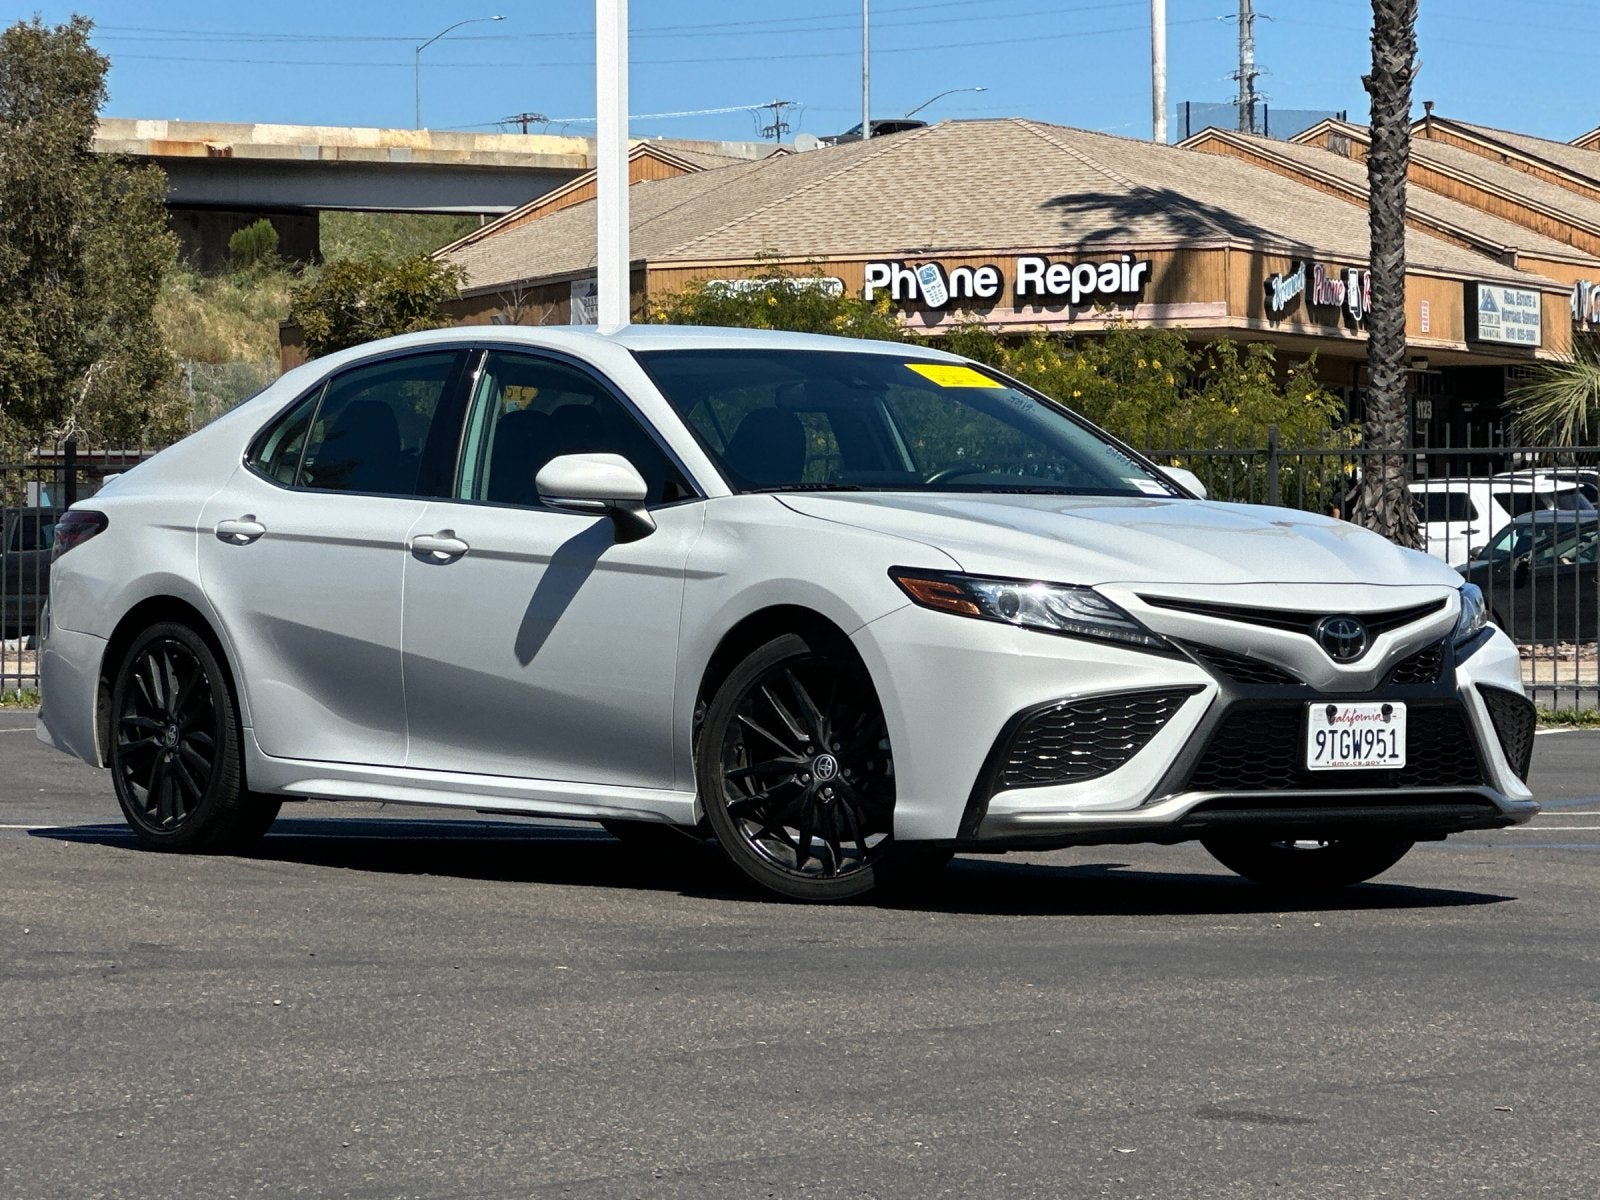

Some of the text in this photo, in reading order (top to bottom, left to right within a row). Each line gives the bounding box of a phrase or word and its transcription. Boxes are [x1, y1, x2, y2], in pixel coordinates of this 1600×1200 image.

[1016, 255, 1147, 304] Repair
[1313, 264, 1345, 307] Phone
[1416, 400, 1433, 419] 1123
[1315, 729, 1399, 760] 9TGW951
